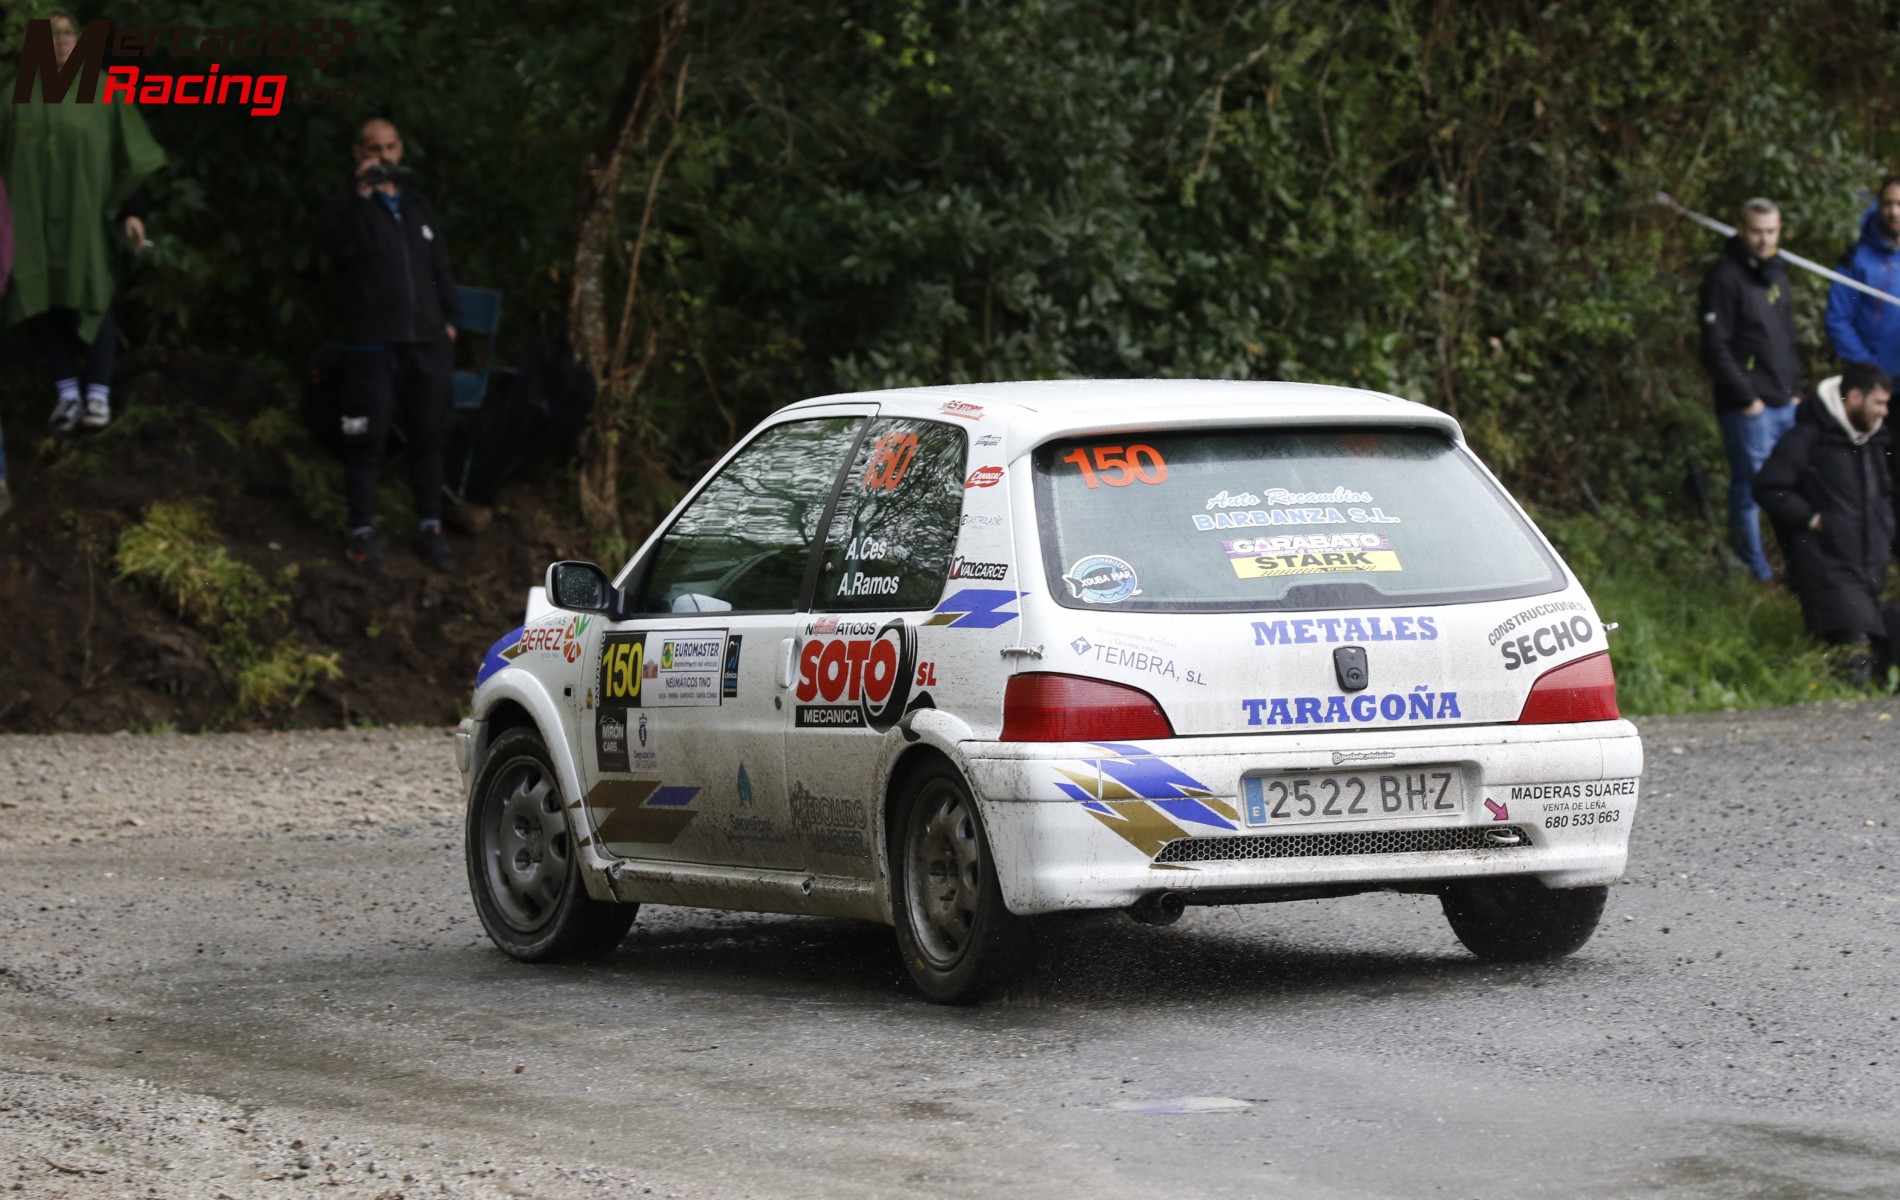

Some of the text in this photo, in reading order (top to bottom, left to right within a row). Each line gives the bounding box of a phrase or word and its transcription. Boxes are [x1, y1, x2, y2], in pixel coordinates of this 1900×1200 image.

[862, 432, 919, 491] 150
[1063, 444, 1168, 489] 150
[1206, 486, 1373, 510] Auto Recambios
[1192, 507, 1401, 531] BARBANZA S.L.
[845, 537, 887, 561] A.Ces
[1230, 532, 1384, 553] GARABATO
[960, 563, 1007, 579] VALCARCE
[1254, 552, 1374, 570] STARK
[837, 572, 899, 596] A.Ramos
[1111, 570, 1133, 582] MAR
[805, 623, 877, 636] NATICOS
[1251, 616, 1439, 646] METALES
[1487, 601, 1587, 646] CONSTRUCCIONES
[518, 628, 564, 653] PEREZ
[674, 642, 719, 657] EUROMASTER
[1501, 615, 1593, 671] SECHO
[602, 642, 642, 698] 150
[796, 639, 897, 703] SOTO
[916, 662, 936, 686] SL
[1186, 670, 1207, 686] S.L.
[698, 677, 712, 688] TINO
[804, 709, 859, 723] MECANICA
[1242, 685, 1462, 725] TARAGOÑA
[602, 722, 624, 739] MIRÓN
[603, 741, 617, 753] CARS
[1268, 772, 1455, 818] 2522 BHZ
[1511, 781, 1635, 800] MADERAS SUAREZ
[1252, 806, 1260, 817] E
[1543, 800, 1607, 812] VENTA DE LEÑA
[1545, 810, 1620, 829] 680 533 663
